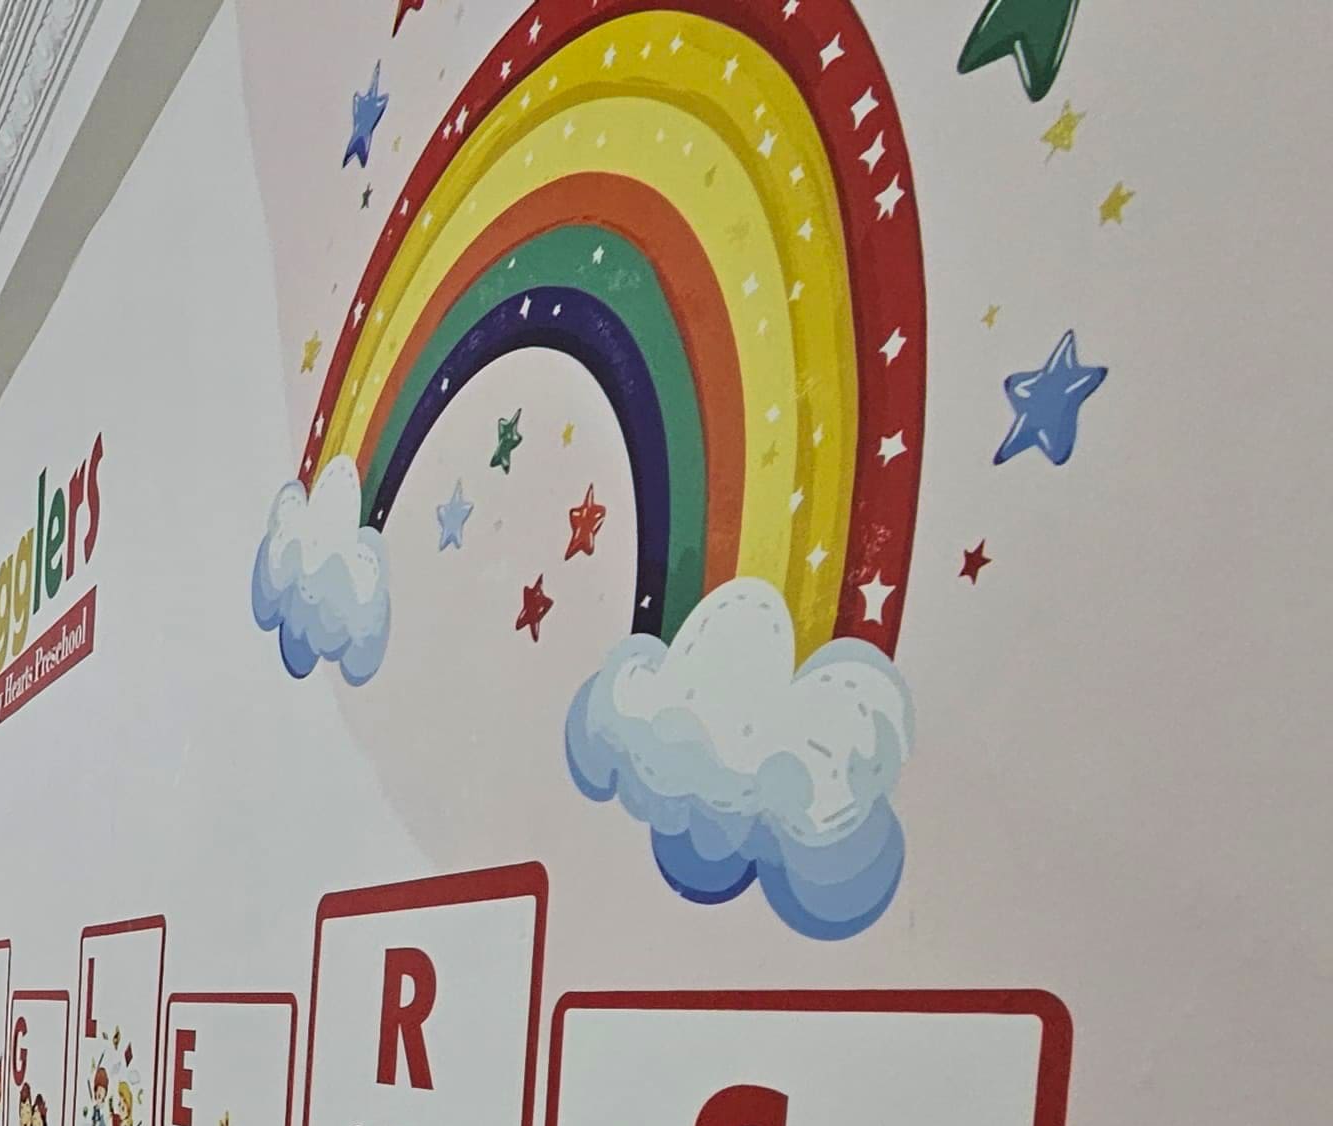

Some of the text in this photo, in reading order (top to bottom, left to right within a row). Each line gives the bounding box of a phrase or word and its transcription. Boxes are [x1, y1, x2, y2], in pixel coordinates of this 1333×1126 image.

[4, 665, 33, 708] Hearts
[34, 606, 87, 683] Preschool
[85, 957, 97, 1038] L
[376, 947, 438, 1090] R
[12, 1016, 28, 1087] G
